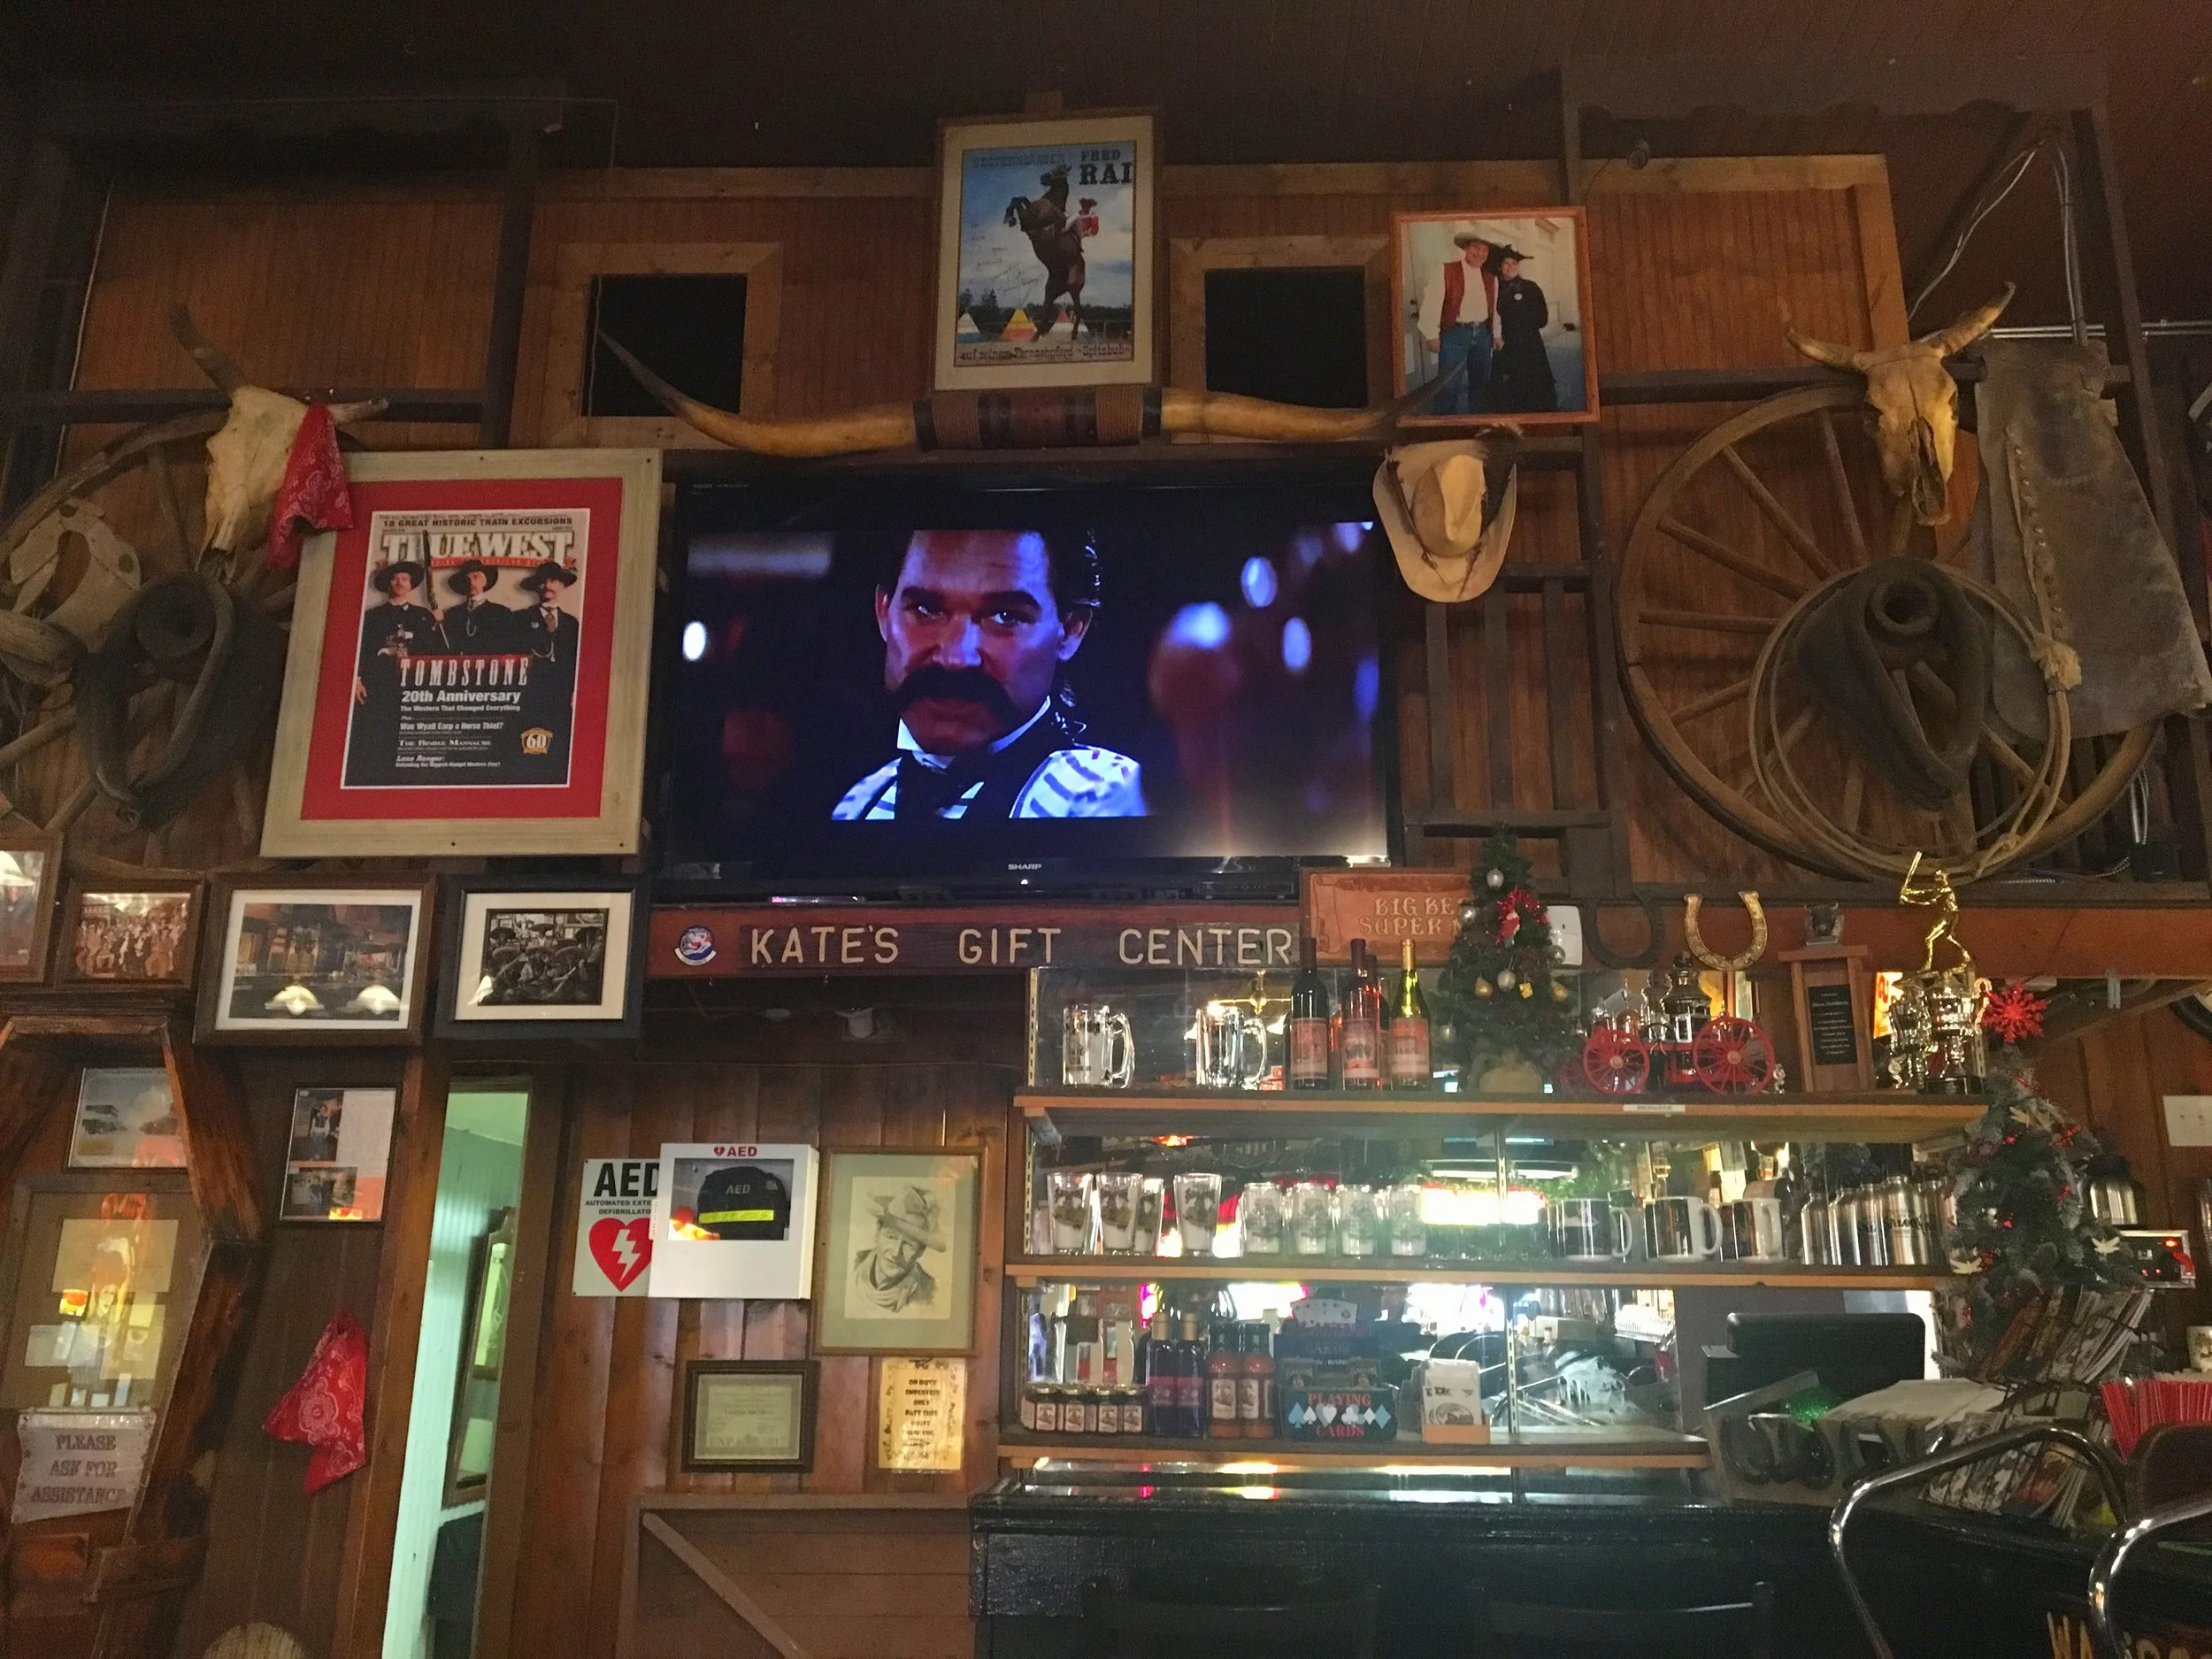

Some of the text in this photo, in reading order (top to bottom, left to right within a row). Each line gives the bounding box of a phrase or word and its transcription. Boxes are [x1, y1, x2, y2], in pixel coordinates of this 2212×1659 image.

[1081, 149, 1121, 163] FRED
[1079, 162, 1133, 186] RAI
[400, 657, 529, 686] TOMBSTONE
[401, 690, 521, 704] 20th Anniversary
[417, 722, 436, 731] Wyatt
[437, 722, 453, 731] Earp
[526, 734, 547, 748] 60
[1374, 896, 1416, 916] BIG
[1359, 917, 1444, 936] SUPER
[750, 926, 1294, 965] KATE'S GIFT CENTER
[726, 1147, 757, 1157] AED
[593, 1162, 659, 1197] AED
[725, 1184, 750, 1194] AED
[1308, 1393, 1371, 1406] PLAYING
[1316, 1425, 1365, 1437] CARDS
[55, 1434, 117, 1451] PLEASE
[50, 1460, 118, 1478] ASK FOR
